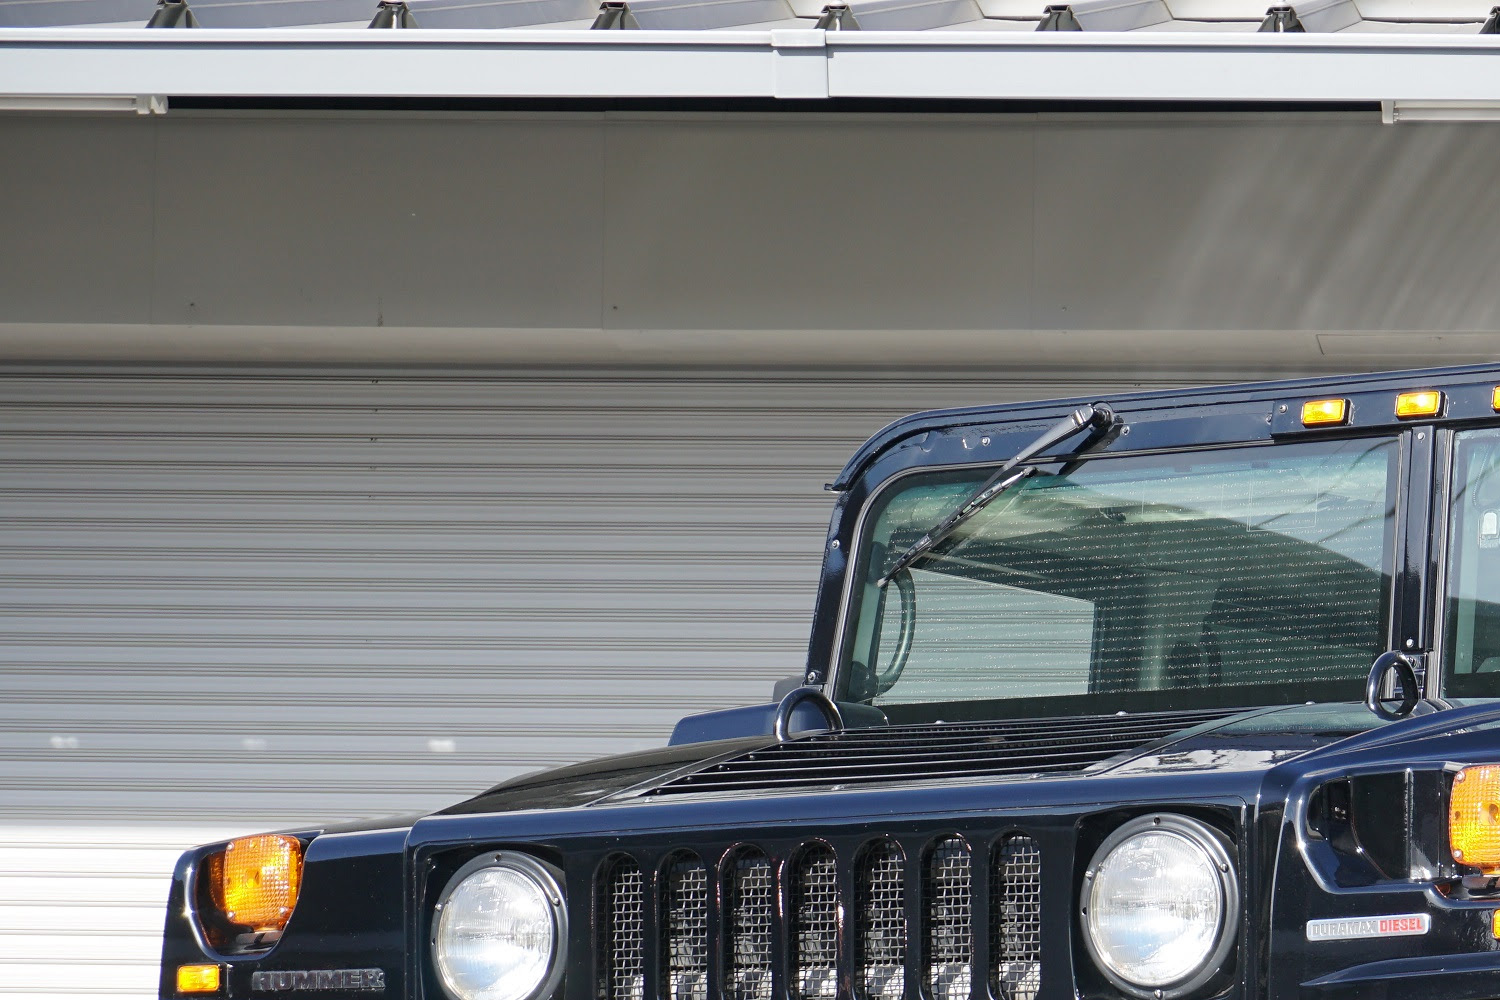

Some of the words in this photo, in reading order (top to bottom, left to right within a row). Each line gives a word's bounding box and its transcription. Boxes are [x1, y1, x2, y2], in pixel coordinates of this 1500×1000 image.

[1312, 920, 1377, 936] DURAMAX
[1379, 918, 1423, 933] DIESEL
[252, 968, 386, 991] HUMMER
